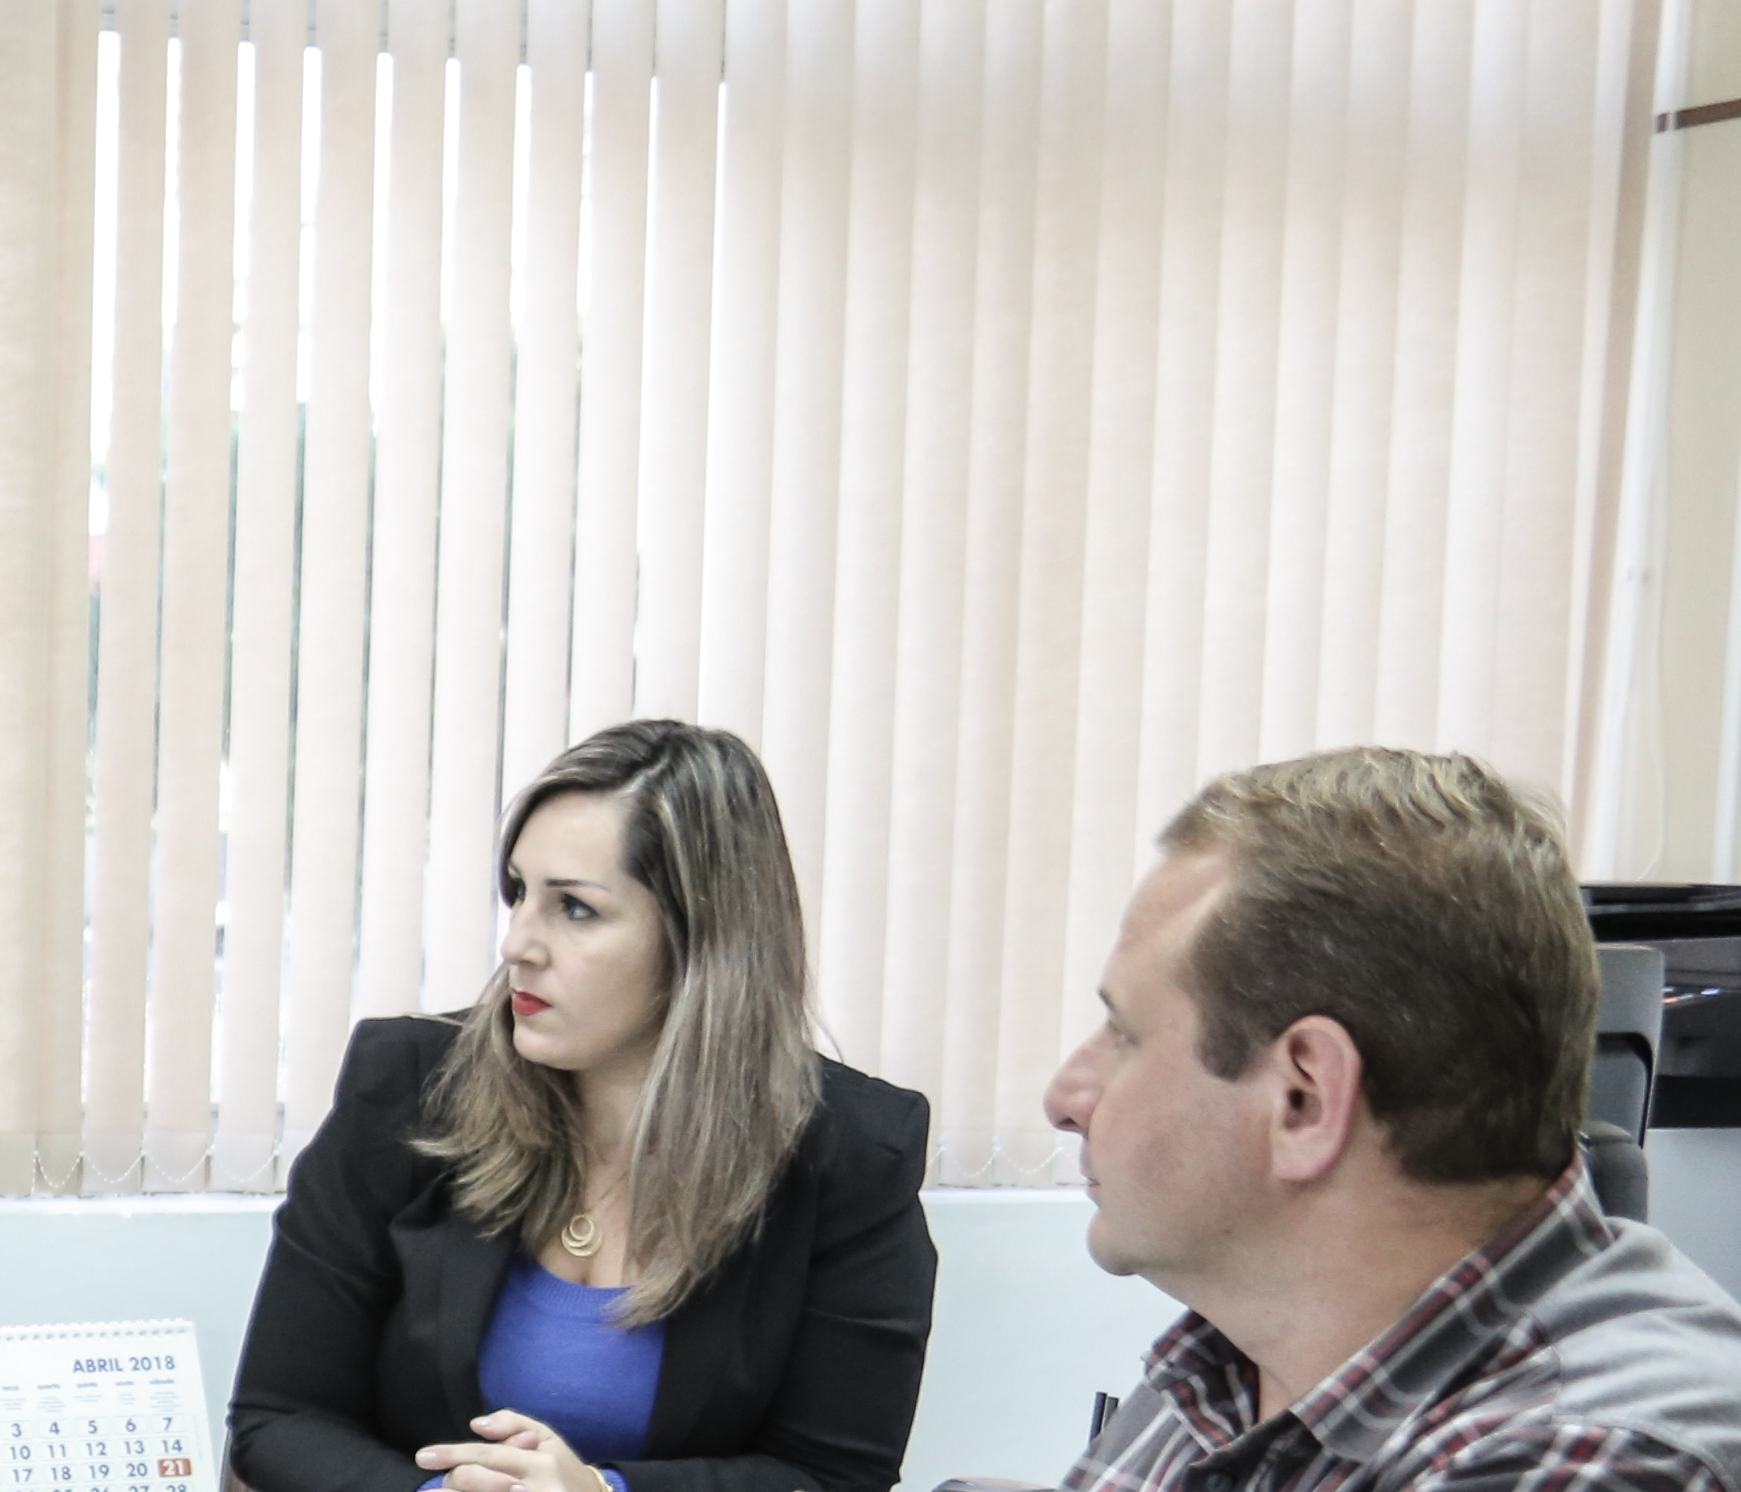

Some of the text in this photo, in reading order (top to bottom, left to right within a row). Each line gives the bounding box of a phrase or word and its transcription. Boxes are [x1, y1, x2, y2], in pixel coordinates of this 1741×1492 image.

[72, 1357, 123, 1374] ABRIL
[128, 1356, 175, 1372] 2018
[11, 1423, 22, 1437] 3
[48, 1422, 60, 1435] 4
[87, 1420, 98, 1434] 5
[125, 1418, 136, 1432] 6
[163, 1417, 173, 1431] 7
[10, 1446, 30, 1460] 10
[48, 1444, 66, 1458] 11
[86, 1442, 107, 1457] 12
[125, 1440, 144, 1454] 13
[162, 1439, 182, 1453] 14
[13, 1469, 33, 1483] 17
[51, 1467, 71, 1481] 18
[89, 1465, 109, 1479] 19
[126, 1463, 148, 1477] 20
[162, 1461, 186, 1475] 21
